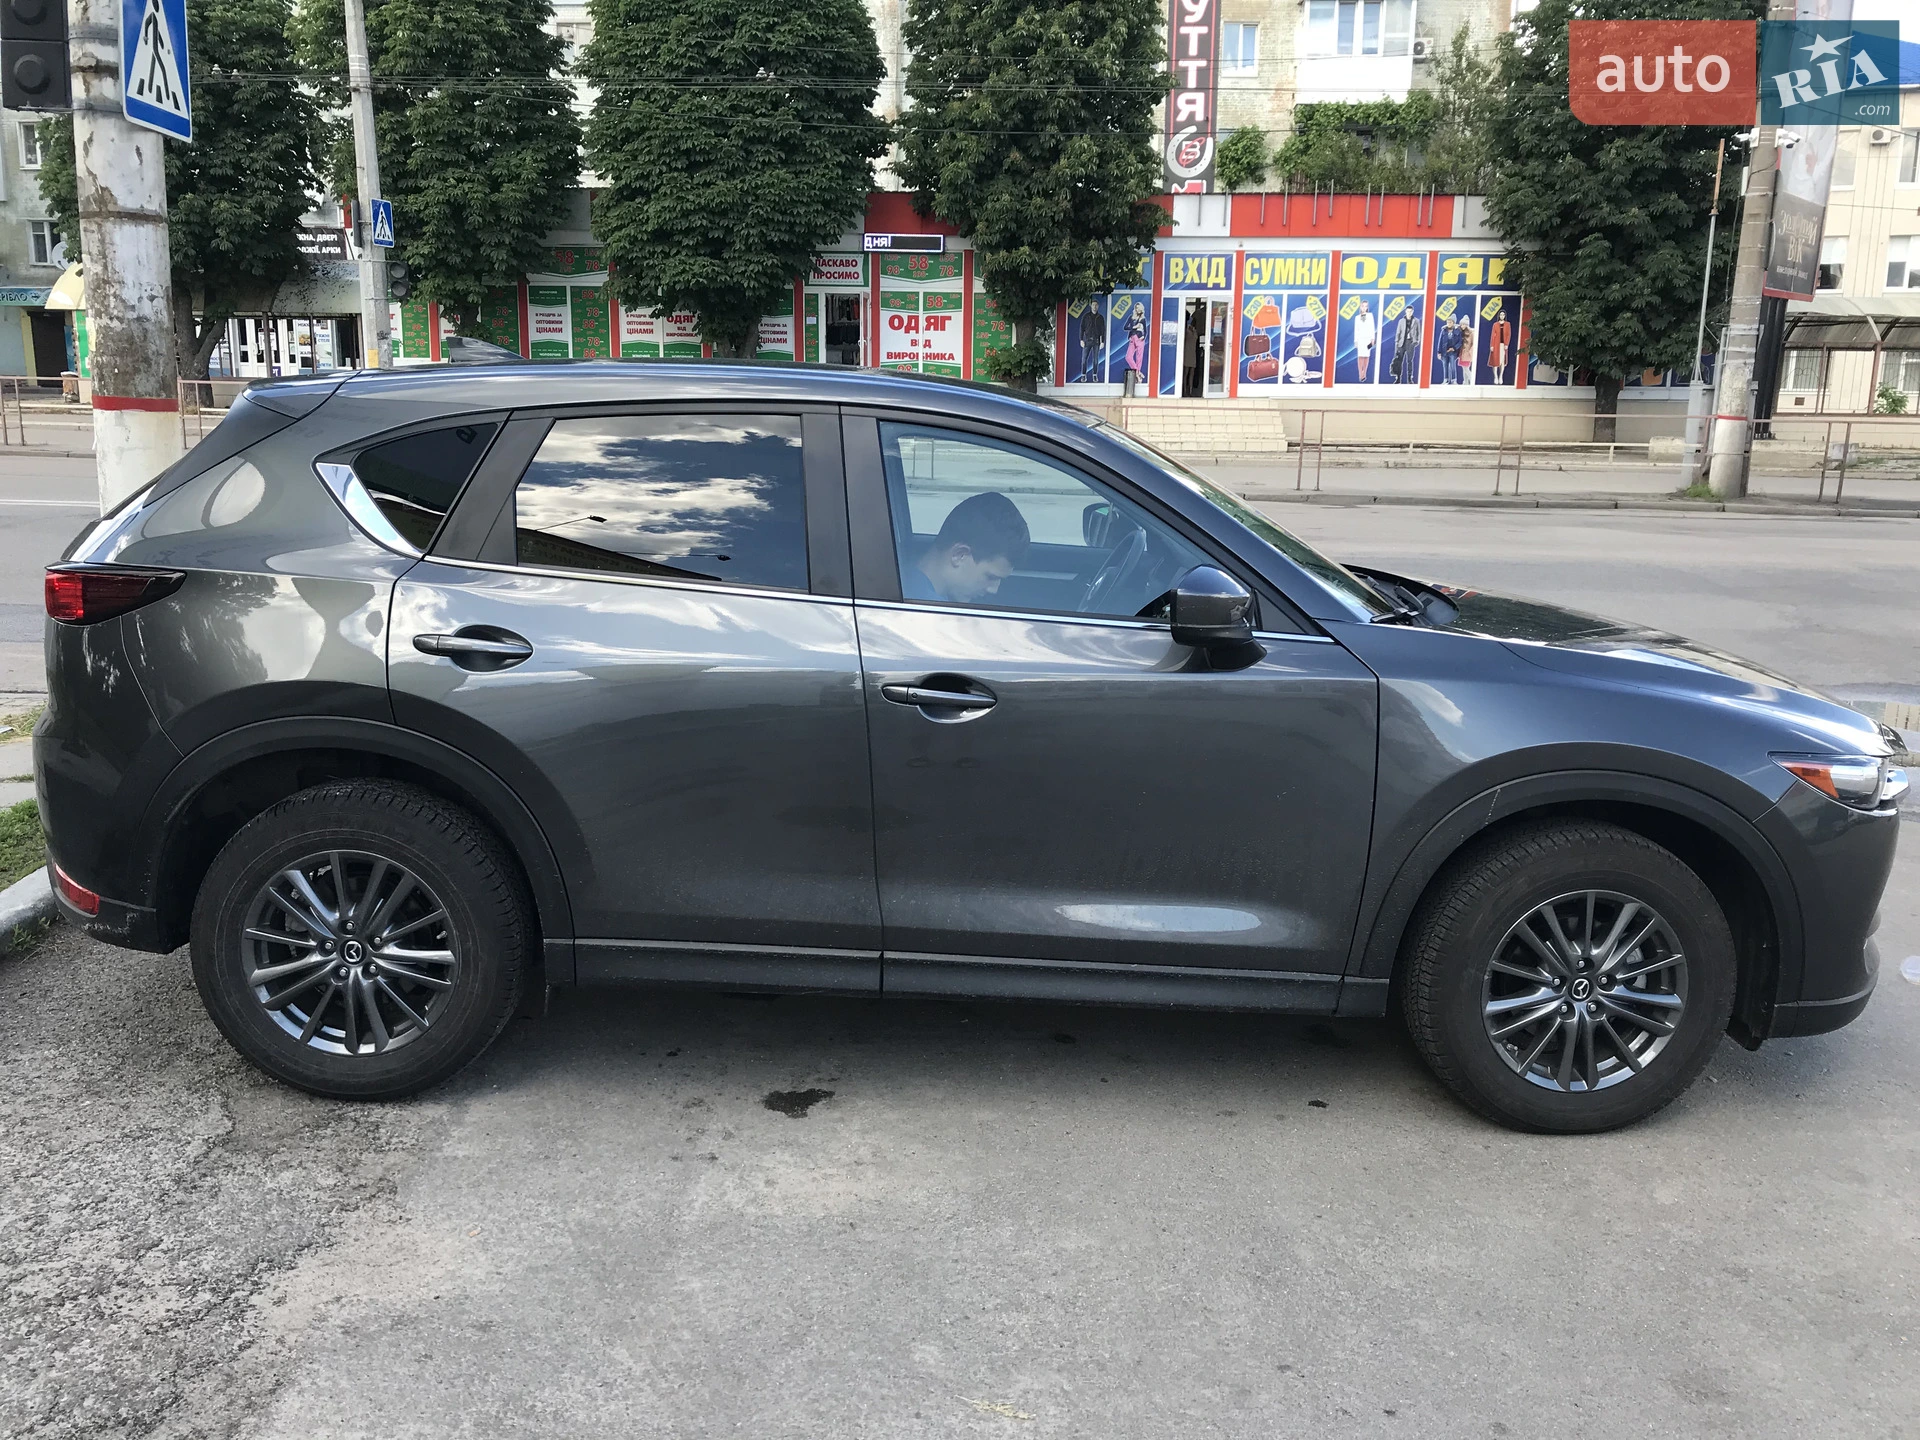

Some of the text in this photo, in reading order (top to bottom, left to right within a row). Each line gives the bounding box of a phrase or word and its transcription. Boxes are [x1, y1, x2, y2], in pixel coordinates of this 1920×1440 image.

[316, 234, 337, 242] ДВЕРІ
[321, 246, 341, 254] АРКИ
[908, 255, 930, 270] 58
[886, 265, 900, 275] 98
[939, 265, 955, 277] 78
[1169, 256, 1226, 289] ВХІД
[1245, 257, 1327, 286] СУМКИ
[926, 295, 944, 308] 58
[586, 307, 600, 317] 78
[666, 314, 696, 324] ОДЯГ
[888, 314, 952, 334] ОДЯГ
[990, 320, 1006, 332] 78
[587, 337, 601, 346] 78
[910, 339, 932, 348] ВІД
